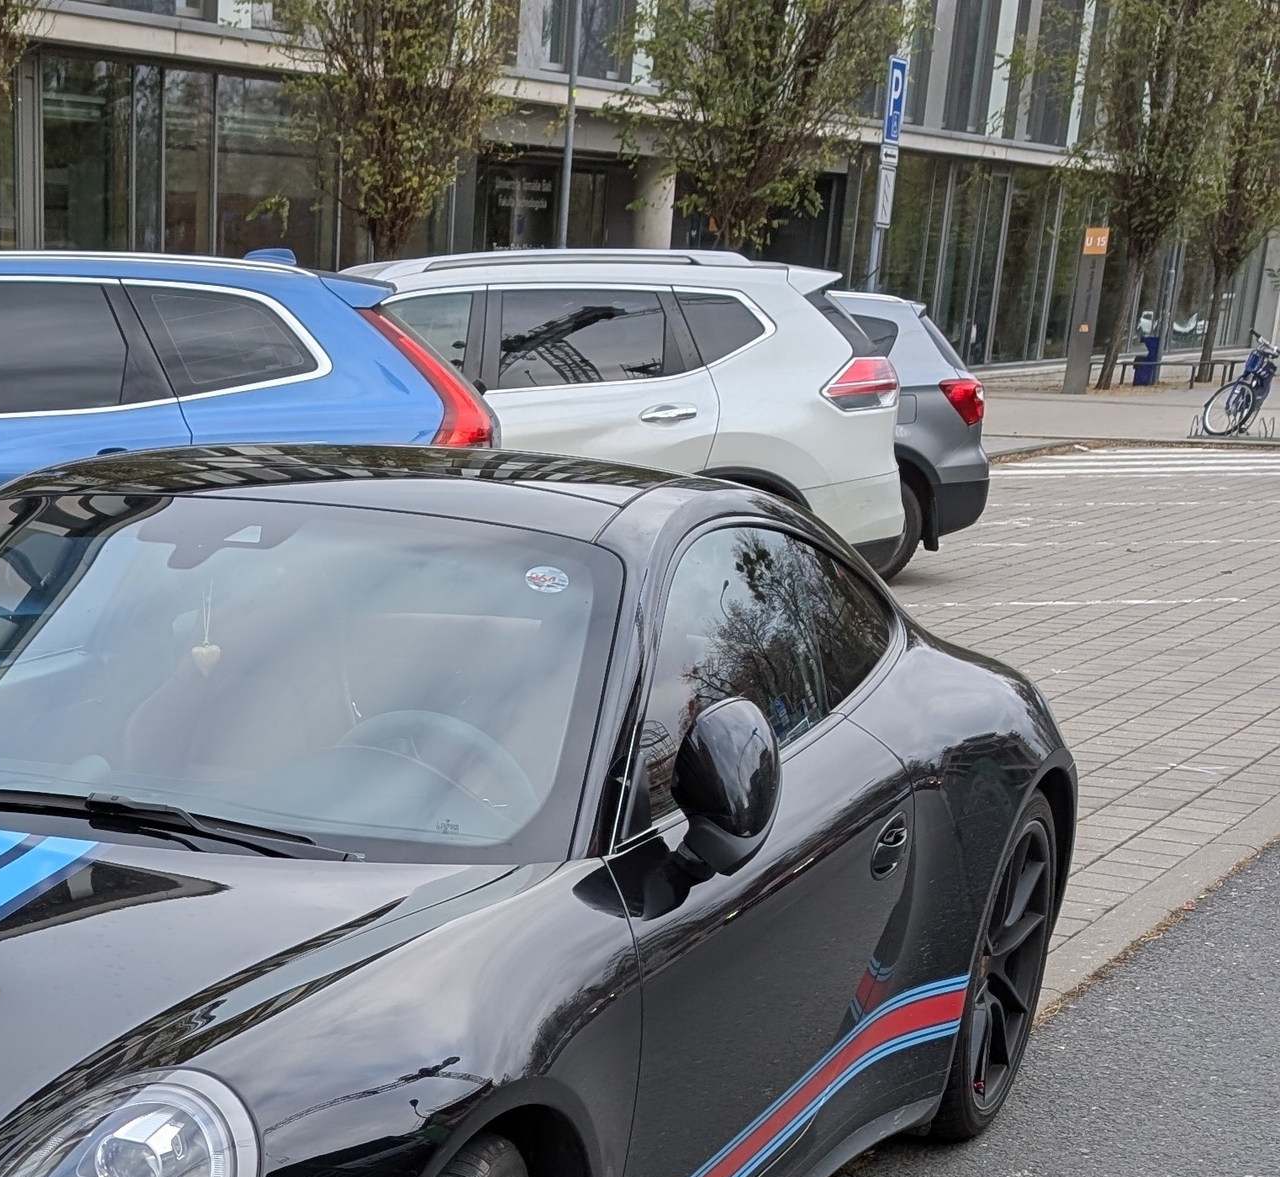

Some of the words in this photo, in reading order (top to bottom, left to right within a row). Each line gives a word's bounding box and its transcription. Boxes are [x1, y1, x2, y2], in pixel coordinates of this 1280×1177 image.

[889, 68, 903, 117] P
[1086, 236, 1093, 247] U
[1096, 236, 1107, 247] 15
